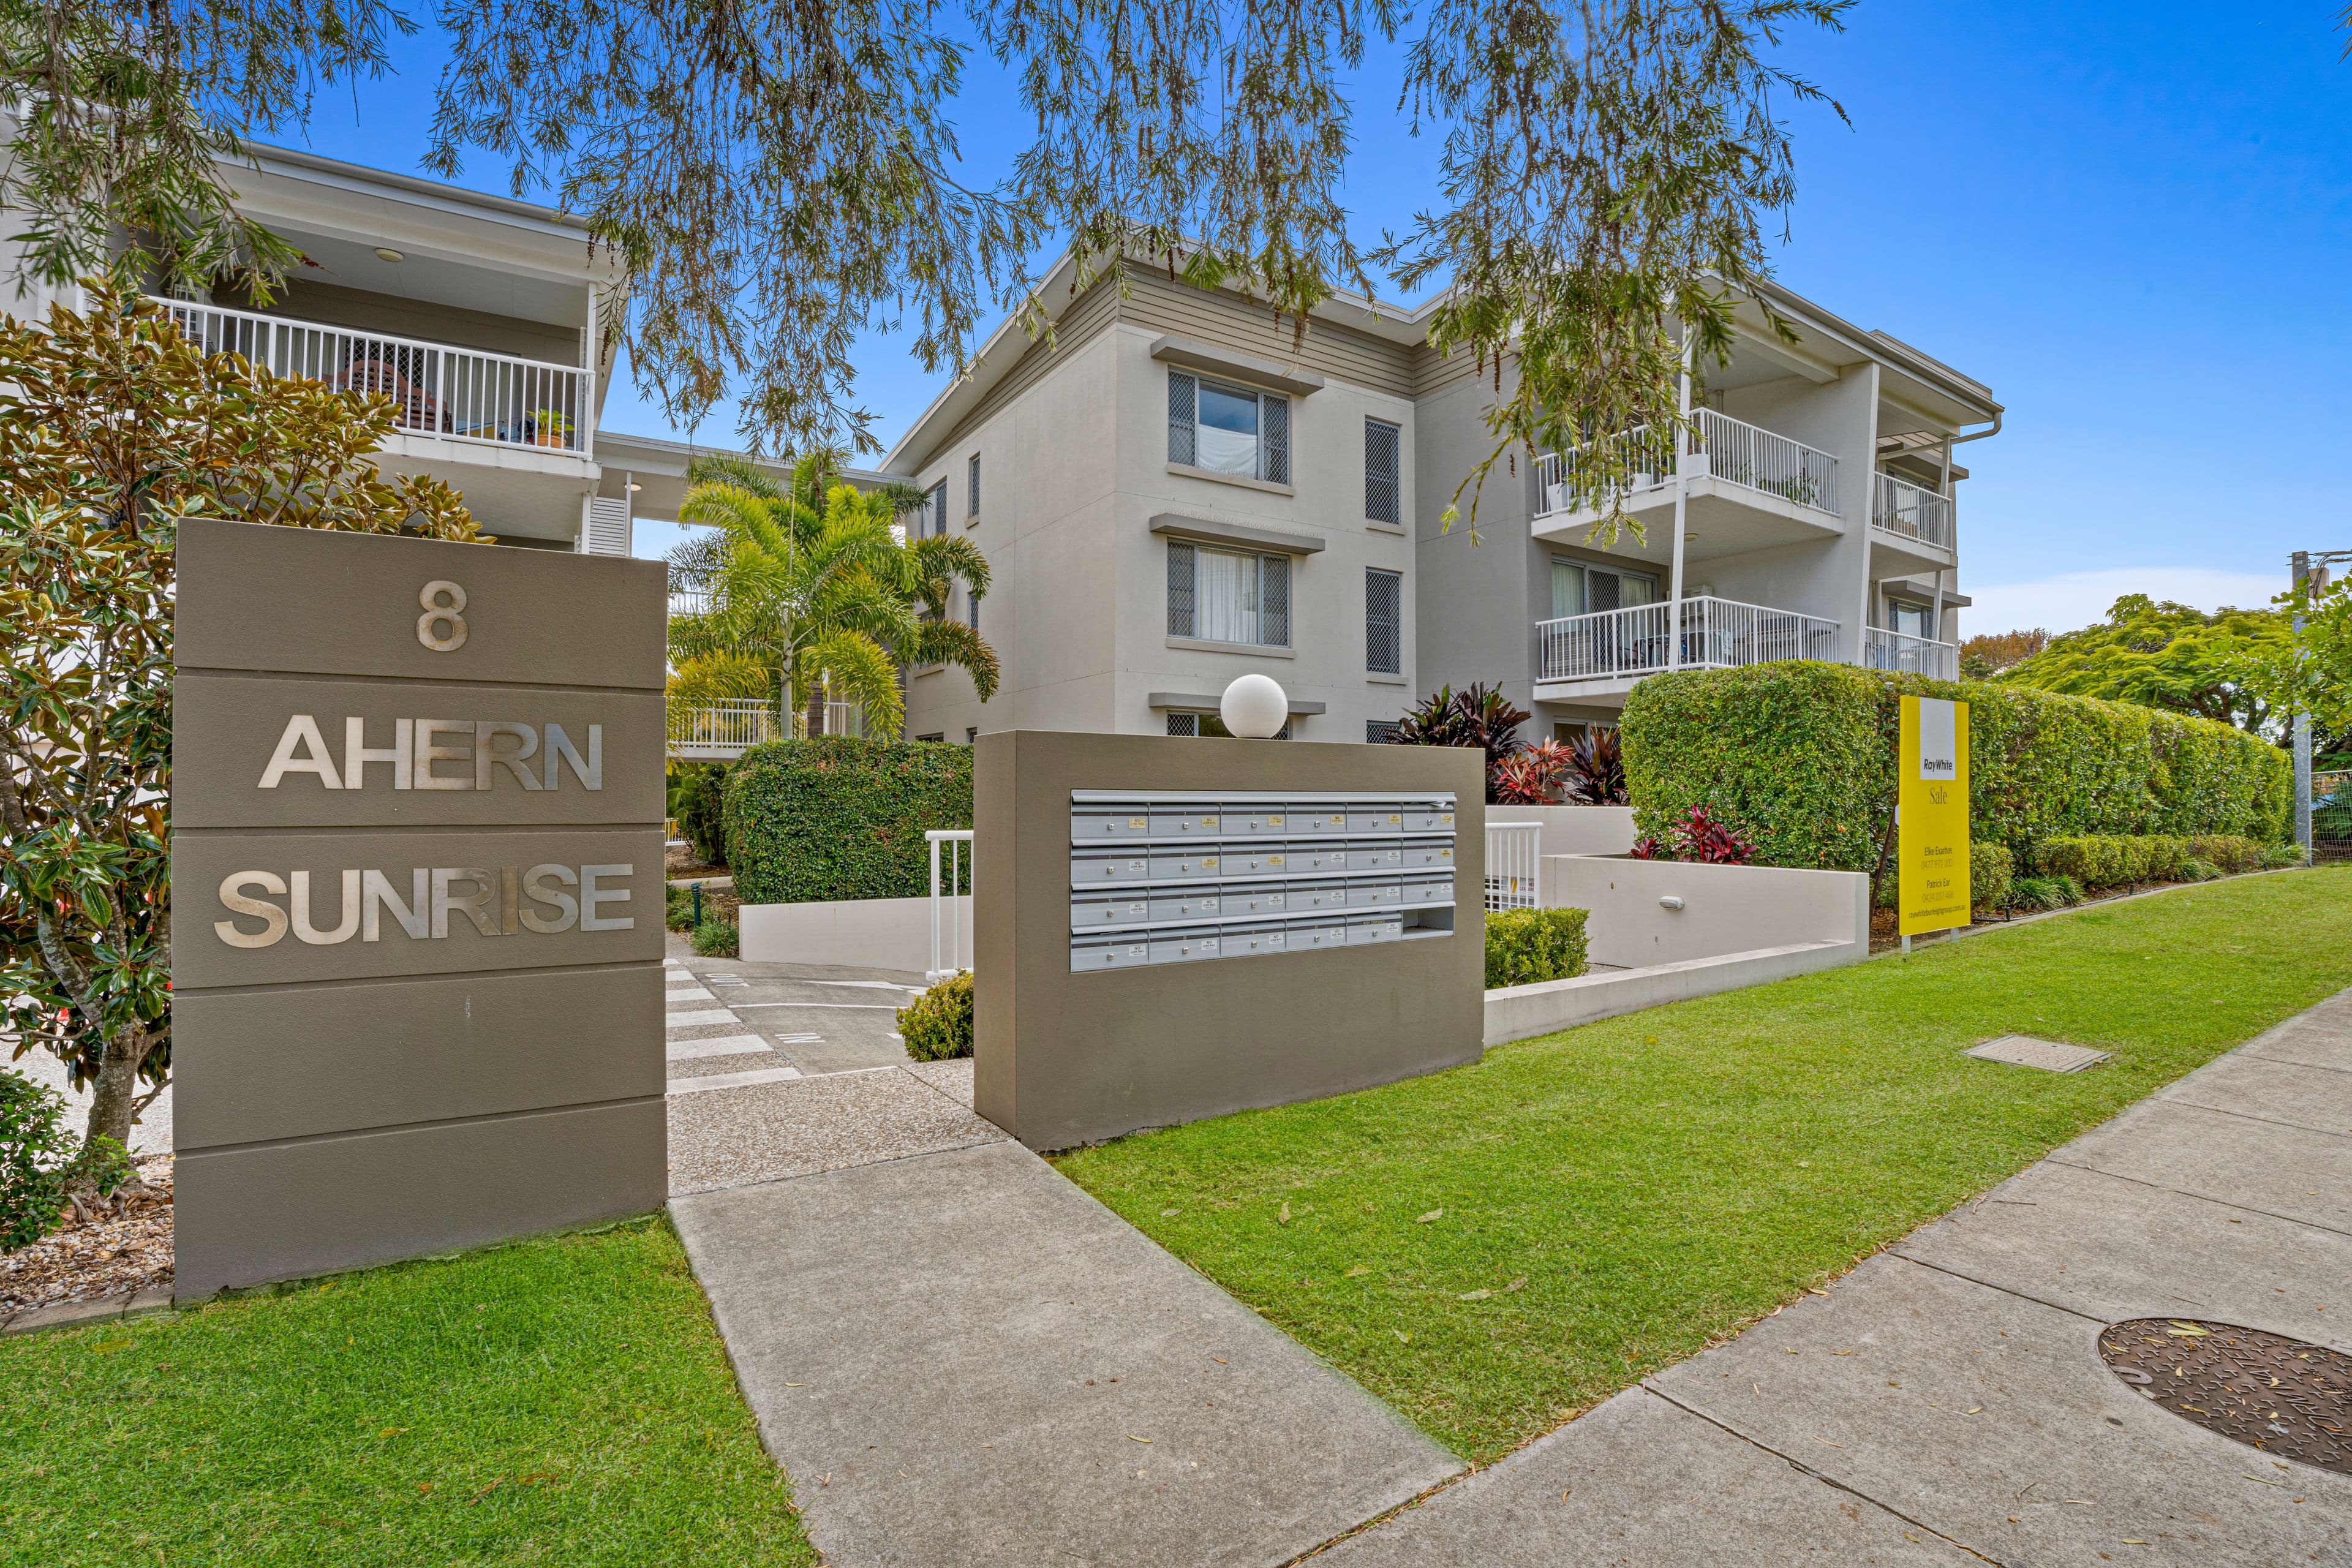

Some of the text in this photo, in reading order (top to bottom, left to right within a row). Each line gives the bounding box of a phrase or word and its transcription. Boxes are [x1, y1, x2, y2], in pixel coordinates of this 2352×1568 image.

[417, 579, 469, 652] 8
[257, 714, 602, 791] AHERN
[1930, 786, 1948, 804] Sale
[1924, 846, 1953, 856] Elke Exarhos
[1926, 878, 1942, 889] Patrick
[213, 863, 635, 949] SUNRISE
[705, 973, 750, 987] OUT
[775, 1032, 826, 1043] IN
